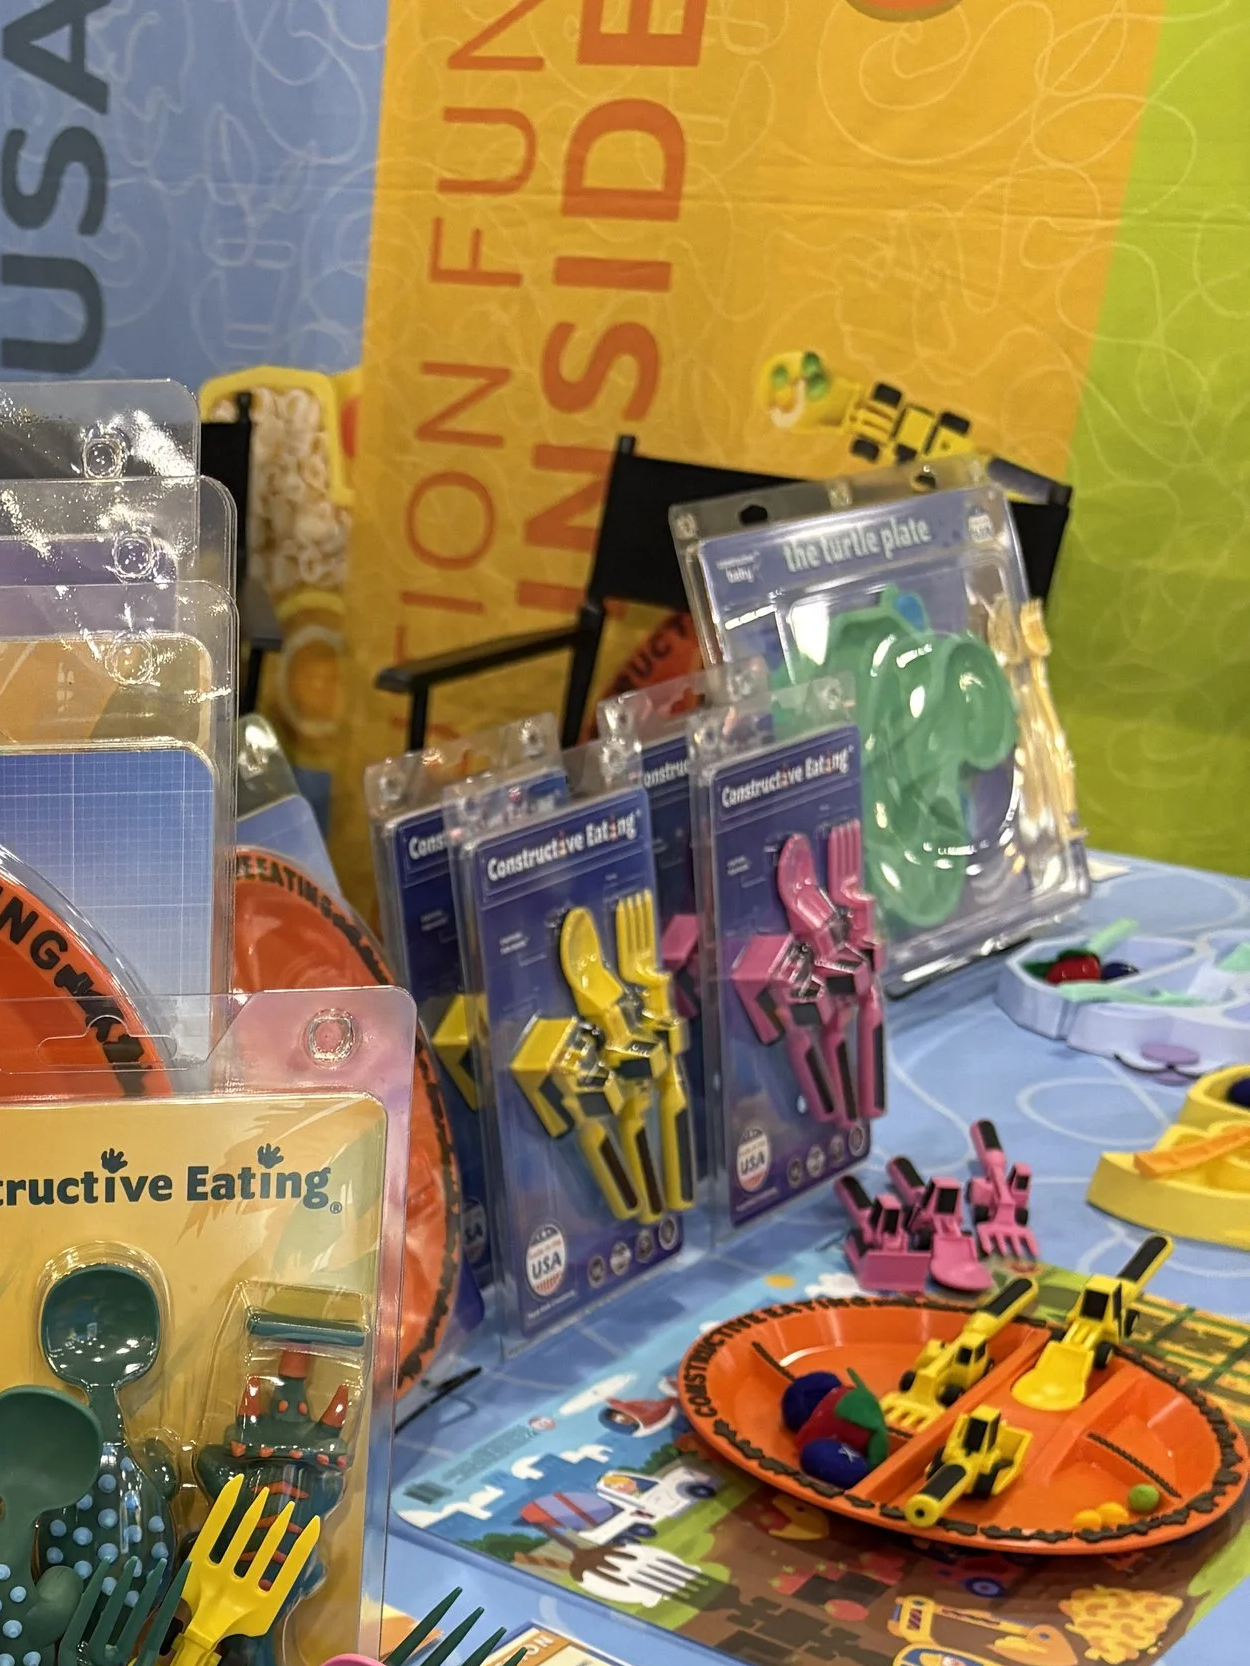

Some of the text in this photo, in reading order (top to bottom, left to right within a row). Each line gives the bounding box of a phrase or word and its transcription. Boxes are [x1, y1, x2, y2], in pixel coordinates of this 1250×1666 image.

[0, 0, 110, 373] USA
[516, 0, 706, 616] INSIDE
[781, 540, 821, 573] the
[821, 524, 882, 565] turtle
[878, 516, 933, 561] plate
[722, 748, 850, 808] Constructive Eating
[487, 828, 584, 882] Constructive
[585, 809, 637, 848] Eating
[739, 1151, 765, 1176] USA
[530, 1252, 563, 1281] USA
